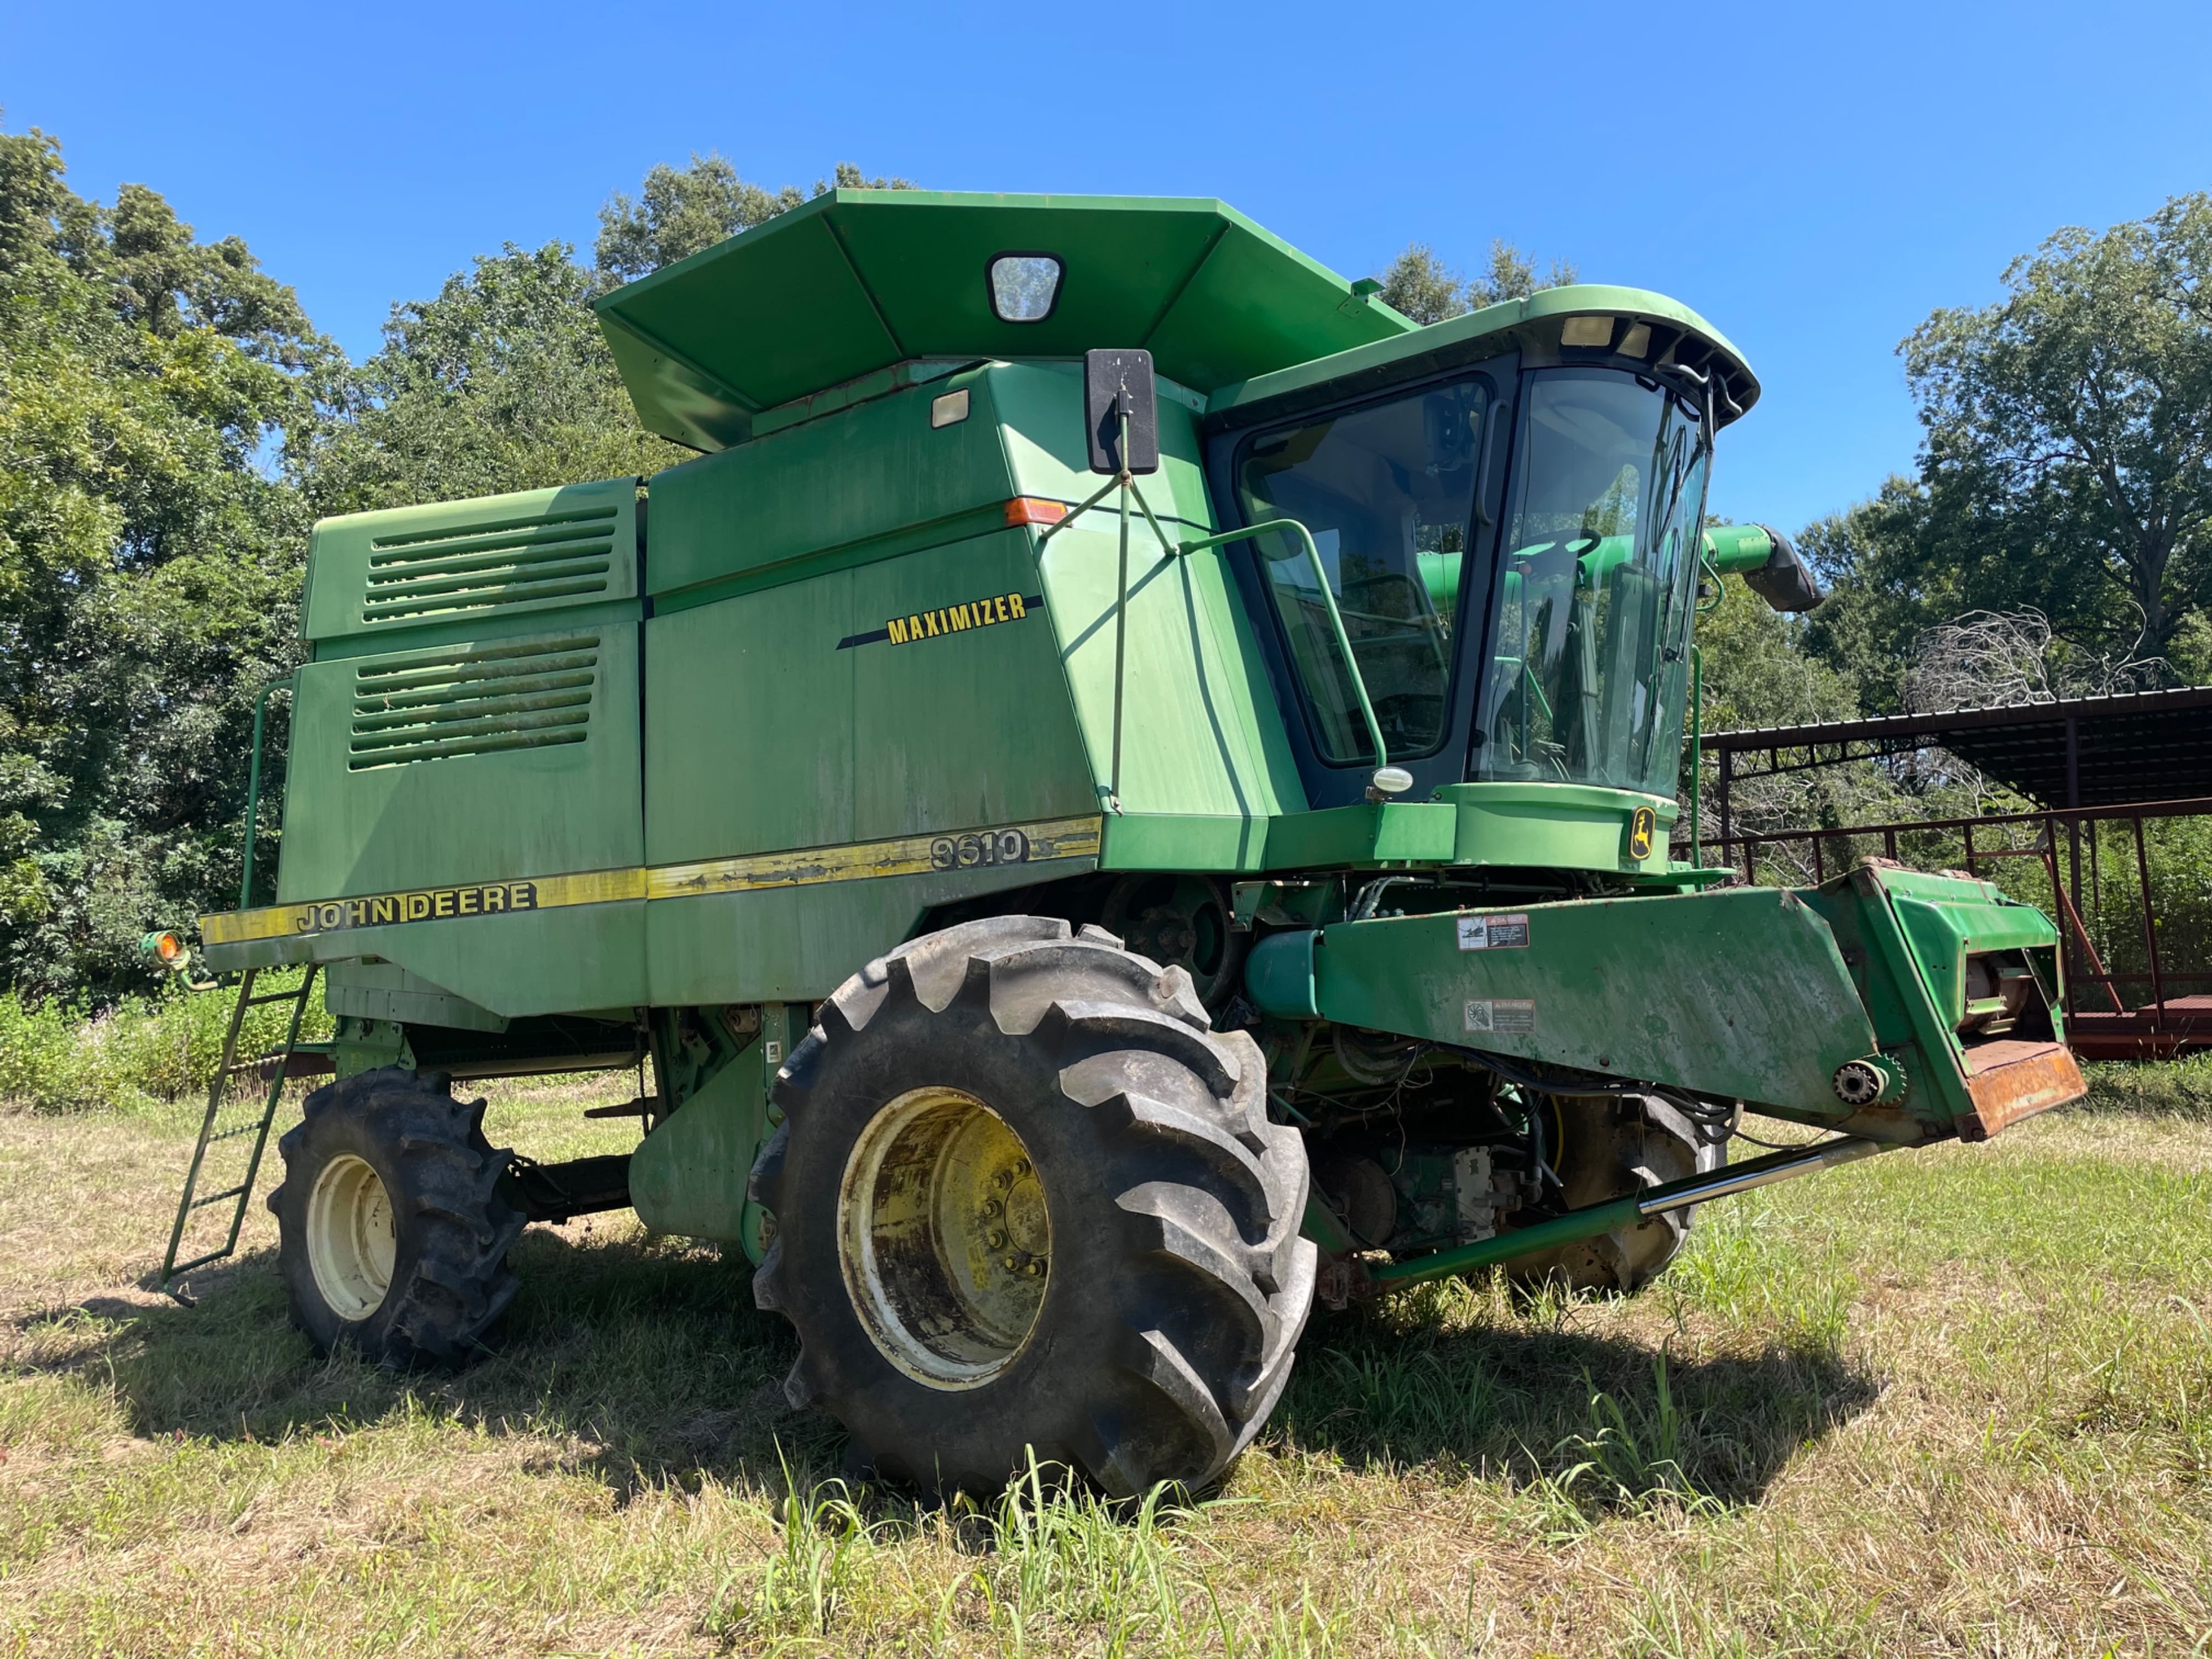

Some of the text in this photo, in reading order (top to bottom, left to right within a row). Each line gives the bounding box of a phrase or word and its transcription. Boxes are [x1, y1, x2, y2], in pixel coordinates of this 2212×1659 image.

[887, 592, 1027, 645] MAXIMIZER
[931, 830, 1029, 870] 9610
[297, 882, 535, 932] JOHN DEERE
